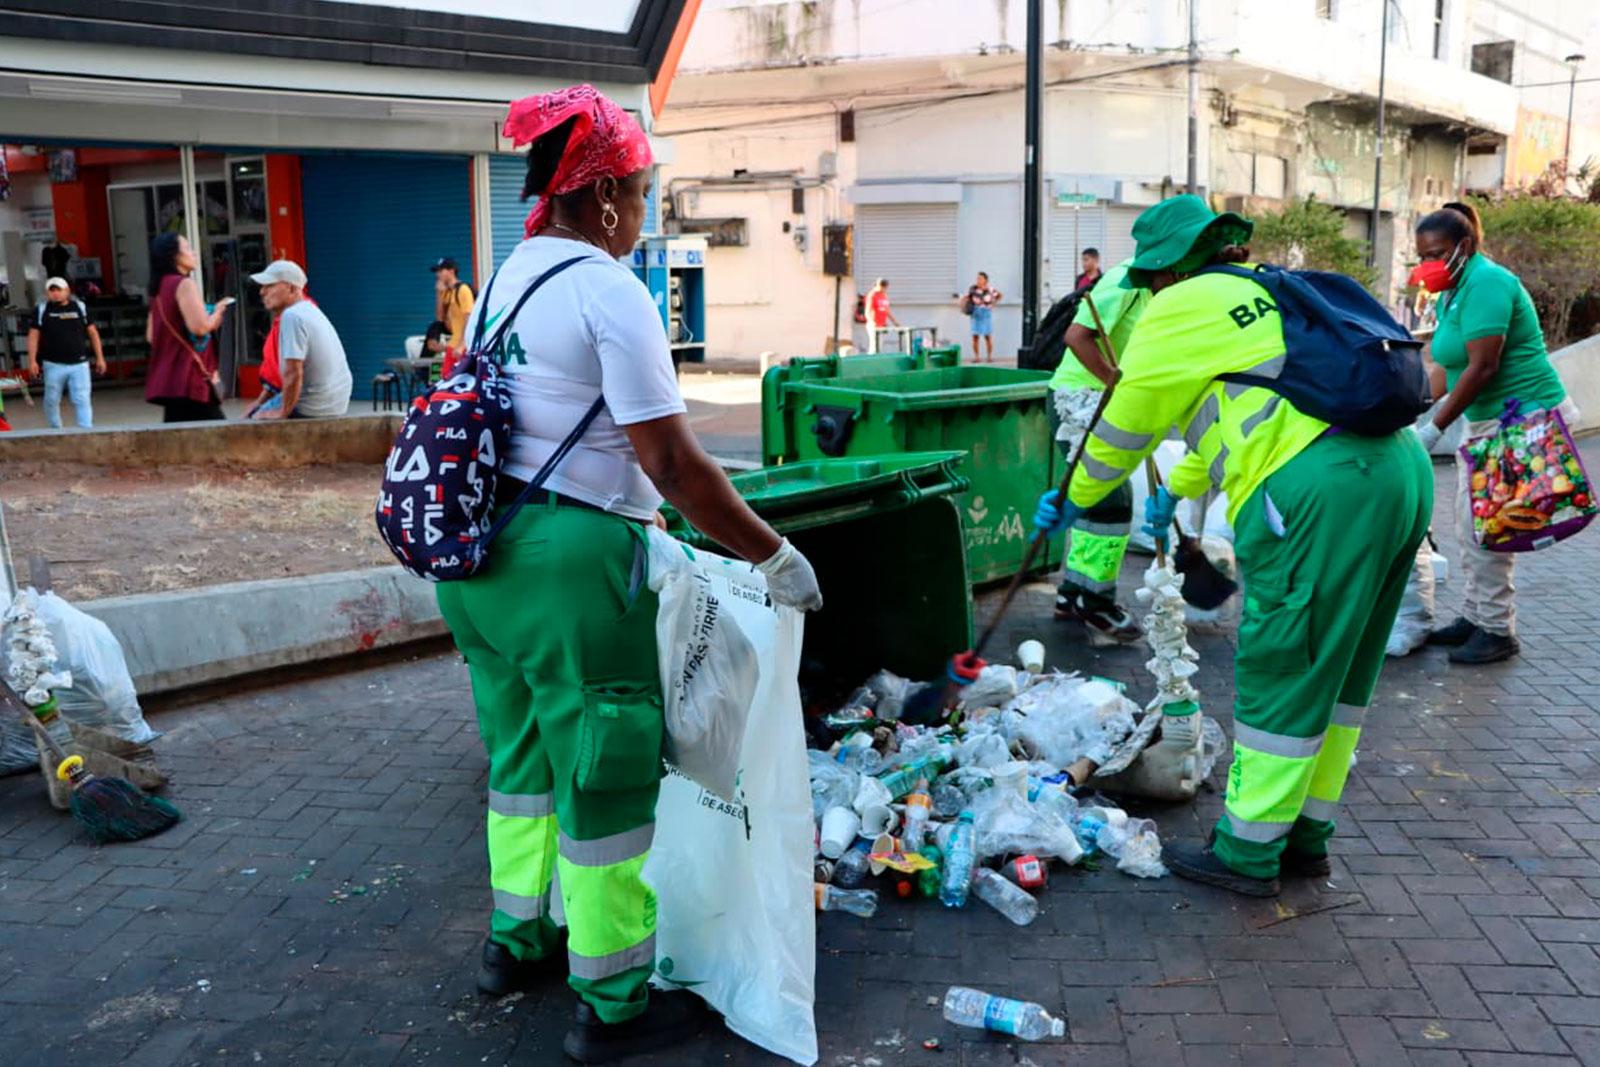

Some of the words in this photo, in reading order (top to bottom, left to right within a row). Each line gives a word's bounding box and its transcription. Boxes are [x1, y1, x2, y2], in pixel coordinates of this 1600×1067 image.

[435, 426, 468, 440] FILA
[401, 495, 416, 544] FILA
[424, 483, 446, 546] FILA
[430, 554, 461, 570] FILA
[701, 796, 717, 809] DE
